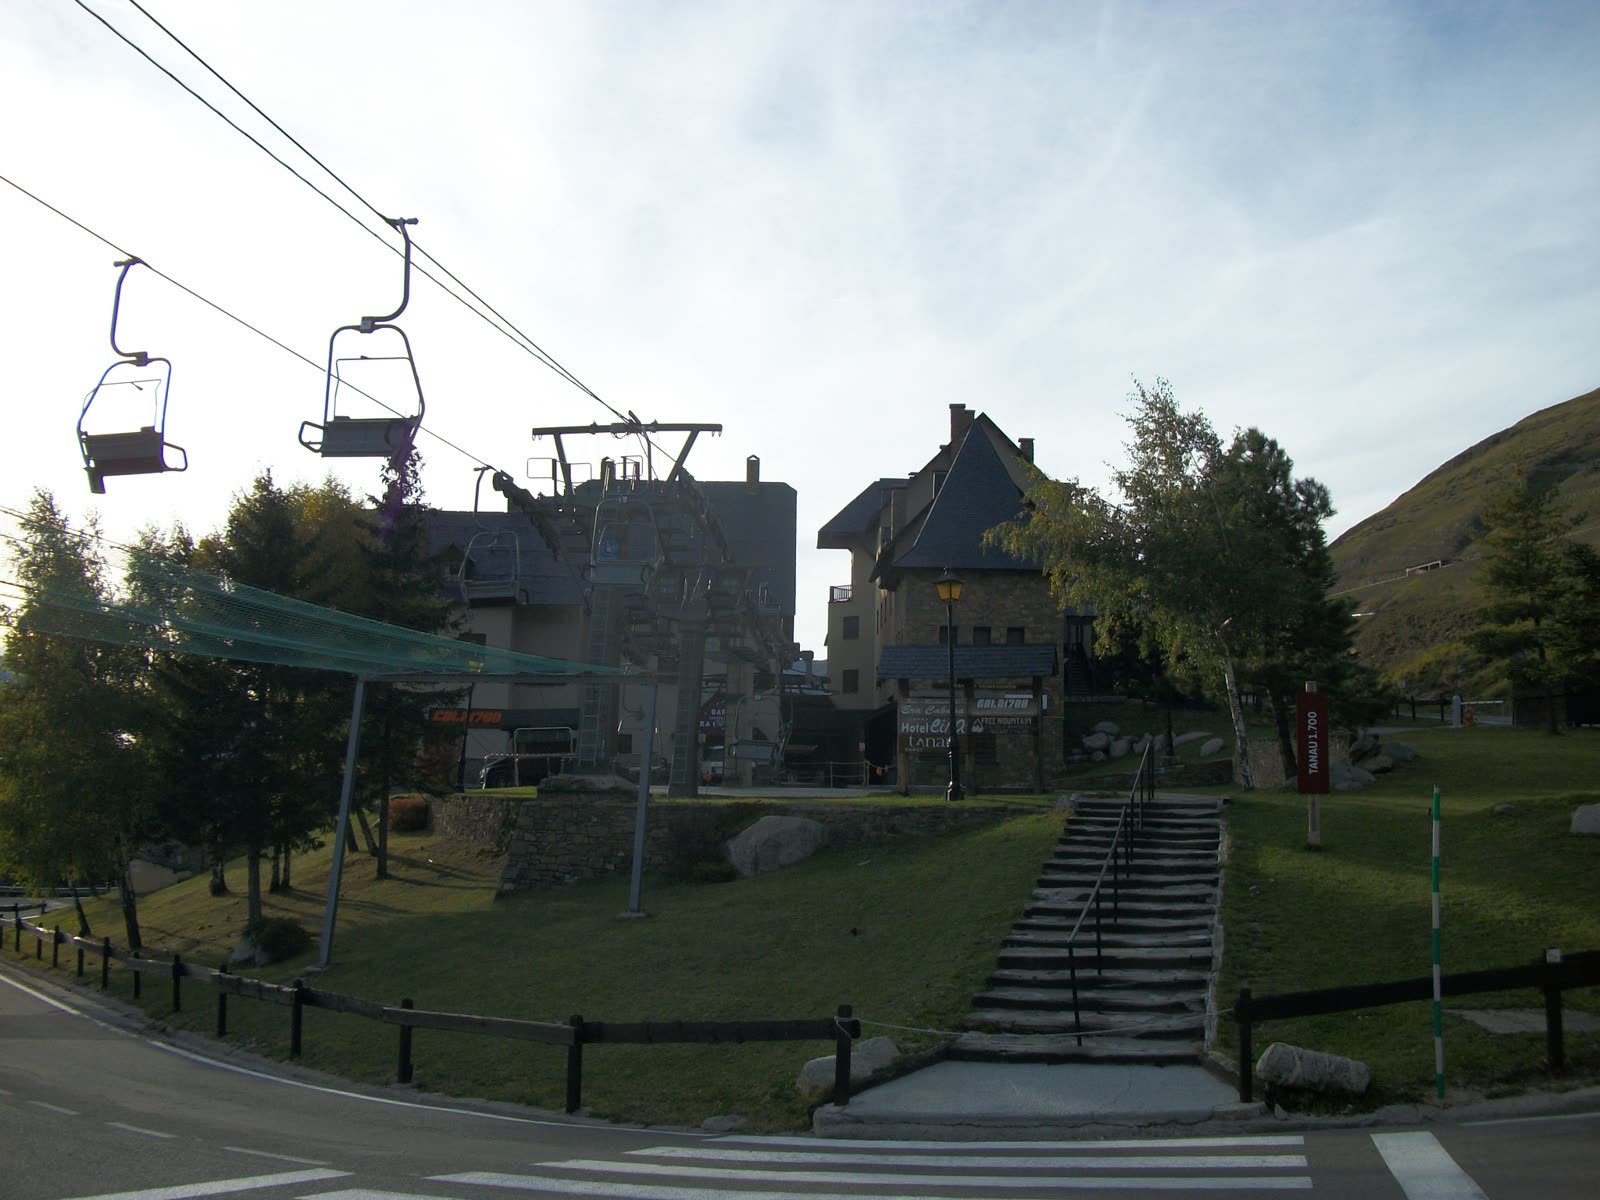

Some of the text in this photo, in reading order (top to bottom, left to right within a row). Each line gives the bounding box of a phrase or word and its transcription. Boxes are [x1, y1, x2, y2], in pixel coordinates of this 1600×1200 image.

[901, 721, 929, 733] Hotel
[981, 717, 997, 725] FREE
[1307, 711, 1319, 775] TANAU 1.700
